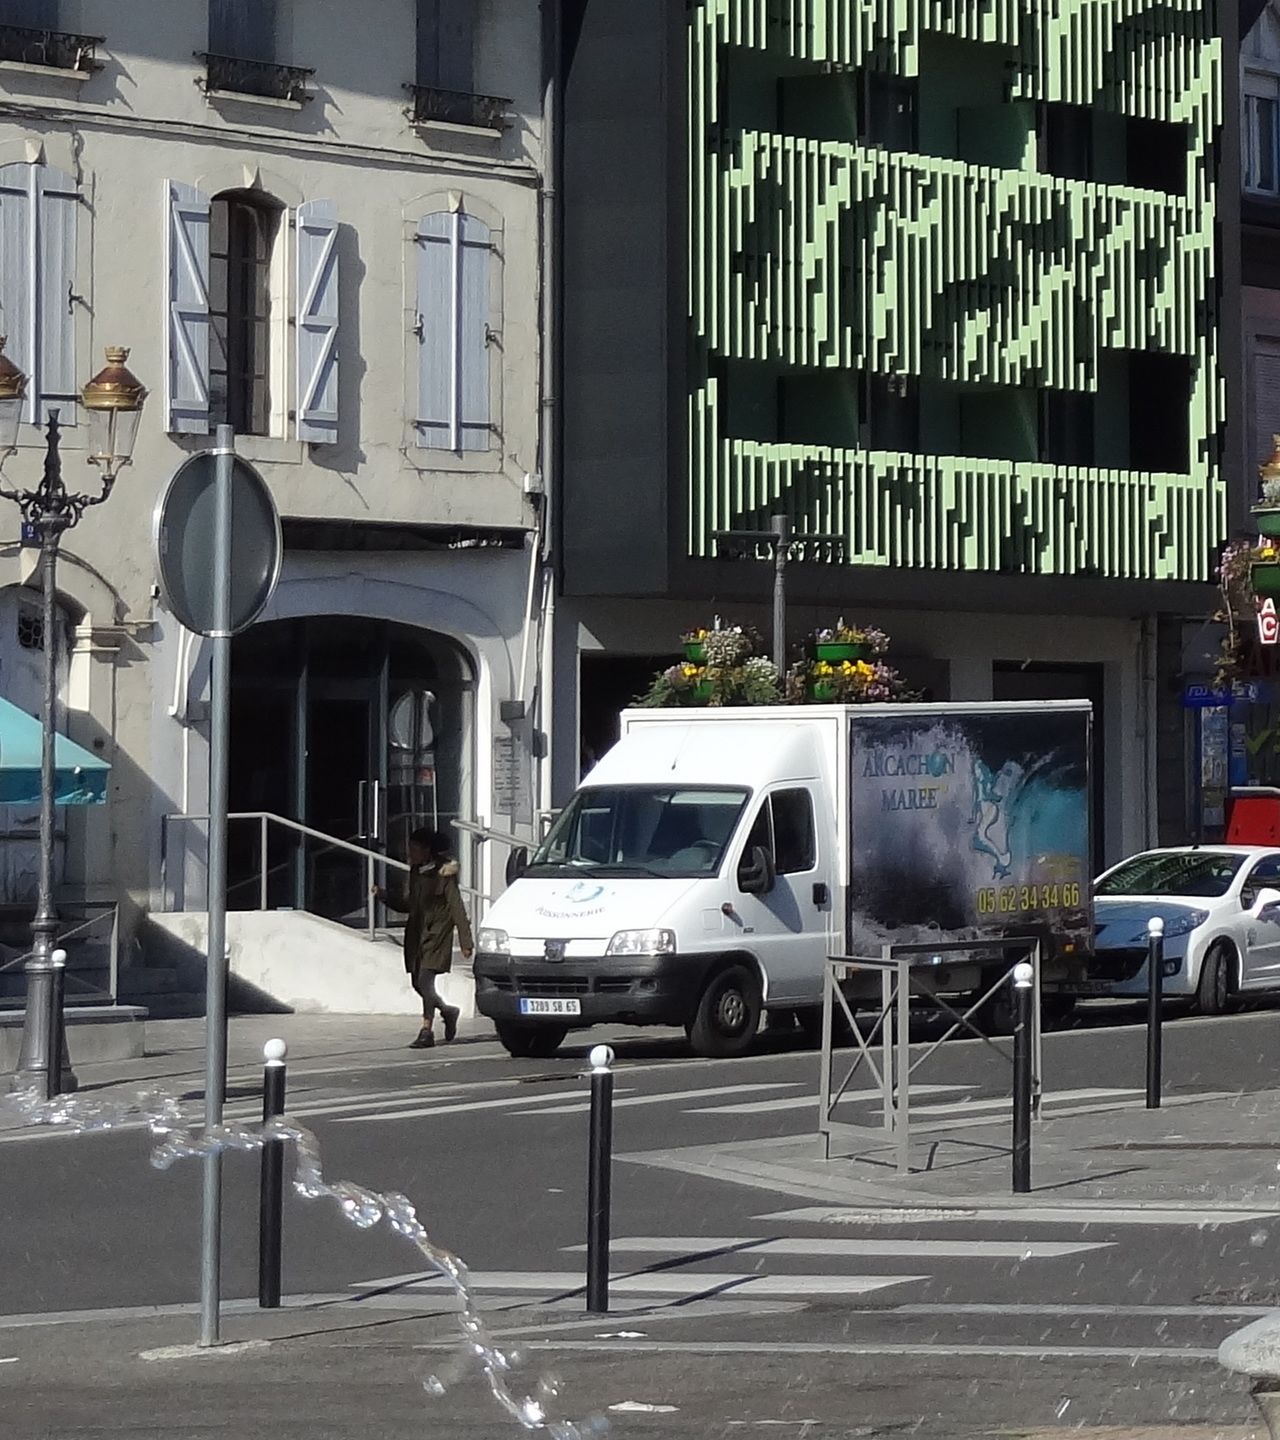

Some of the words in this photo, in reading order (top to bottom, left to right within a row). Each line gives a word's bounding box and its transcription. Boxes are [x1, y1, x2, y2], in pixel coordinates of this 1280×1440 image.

[978, 888, 997, 914] 05
[1000, 886, 1017, 912] 62
[1021, 886, 1038, 910] 34
[1042, 884, 1059, 909] 34
[1063, 882, 1080, 907] 66
